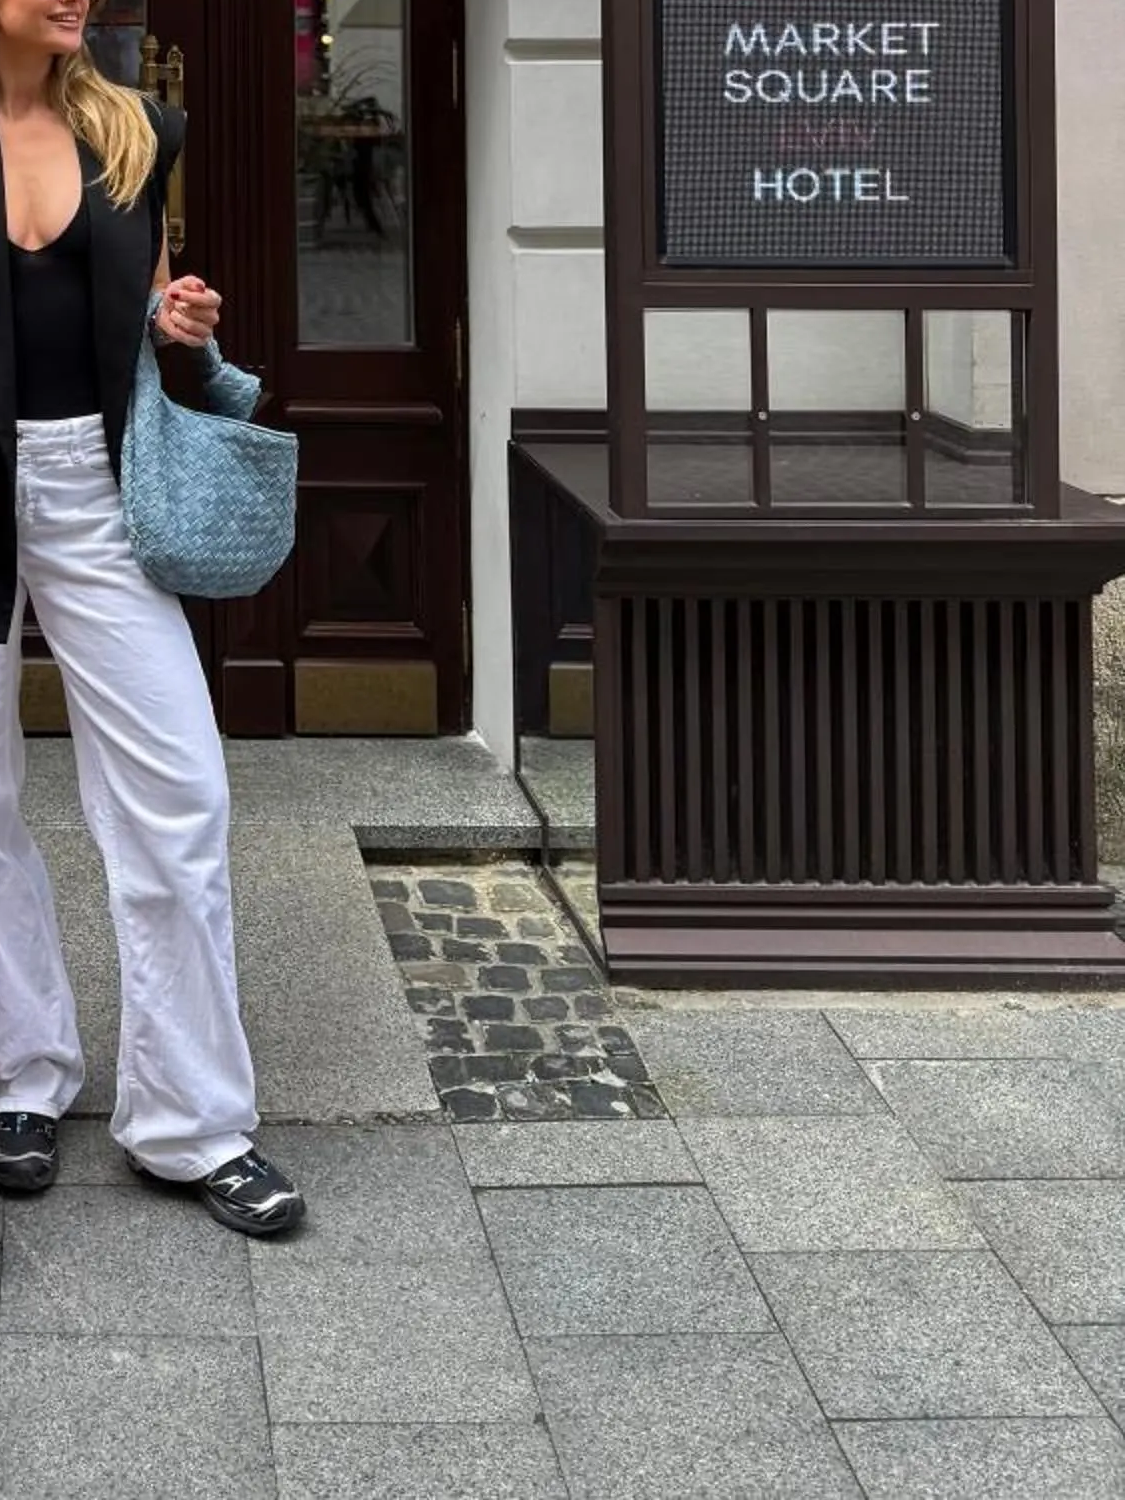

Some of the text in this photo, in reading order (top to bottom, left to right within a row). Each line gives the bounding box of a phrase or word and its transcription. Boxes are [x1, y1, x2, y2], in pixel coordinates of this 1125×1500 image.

[725, 22, 941, 56] MARKET
[724, 69, 932, 103] SQUARE
[754, 167, 910, 202] HOTEL
